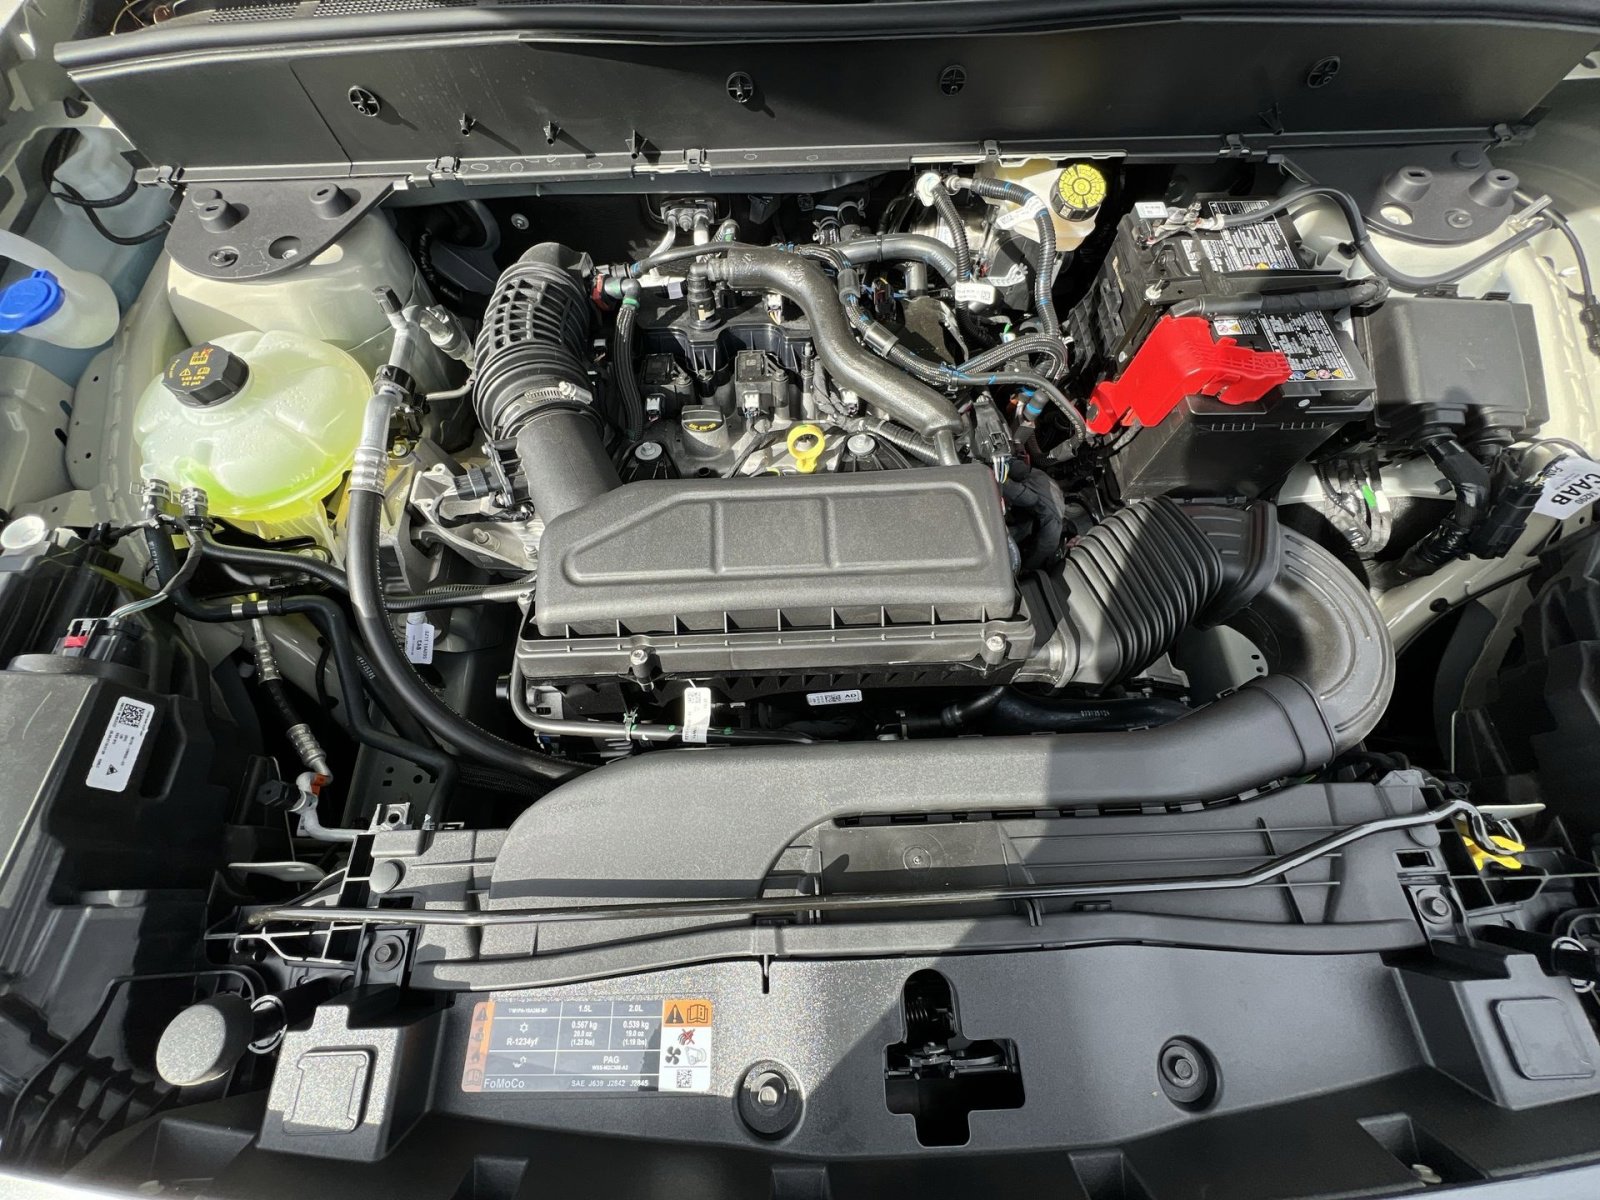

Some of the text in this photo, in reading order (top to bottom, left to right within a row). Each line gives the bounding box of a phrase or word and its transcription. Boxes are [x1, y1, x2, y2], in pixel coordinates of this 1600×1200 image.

[1550, 473, 1600, 505] CAAB
[578, 1004, 593, 1013] 1.5L
[628, 1004, 644, 1012] 2.0L
[571, 1020, 598, 1031] 0.567 kg
[622, 1020, 650, 1030] 0.539 kg
[506, 1037, 539, 1047] R-1234yf
[602, 1055, 620, 1064] PAG
[483, 1078, 526, 1089] FoMoCo
